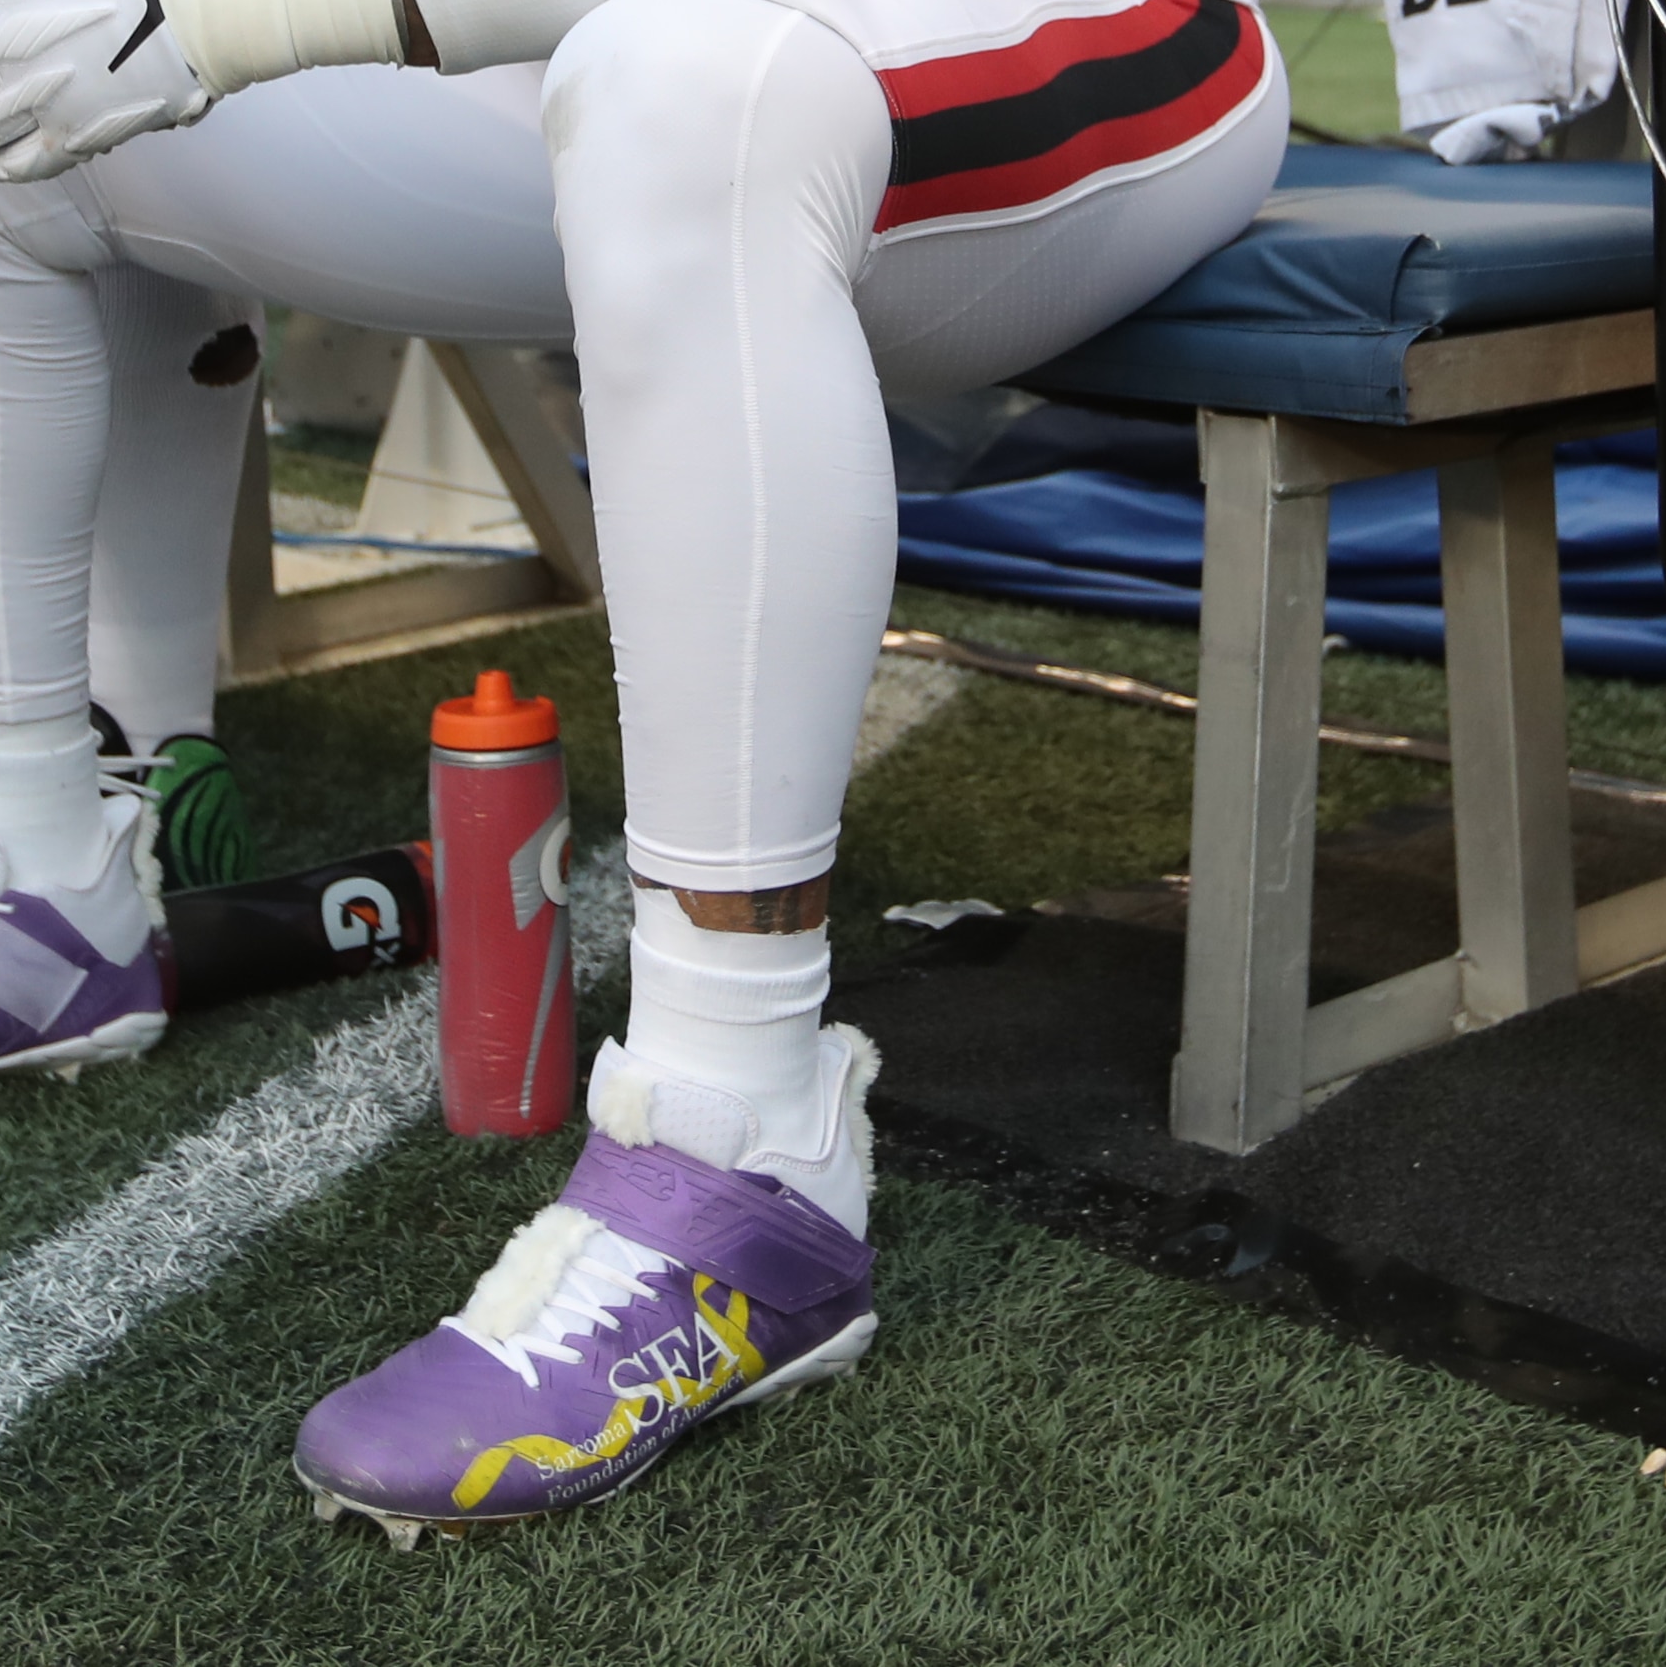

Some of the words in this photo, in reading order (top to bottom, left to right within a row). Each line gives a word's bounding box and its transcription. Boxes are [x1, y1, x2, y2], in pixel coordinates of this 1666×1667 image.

[608, 1310, 741, 1436] SFA
[535, 1421, 629, 1482] Sarcoma
[545, 1434, 659, 1506] Foundation
[661, 1413, 680, 1440] of
